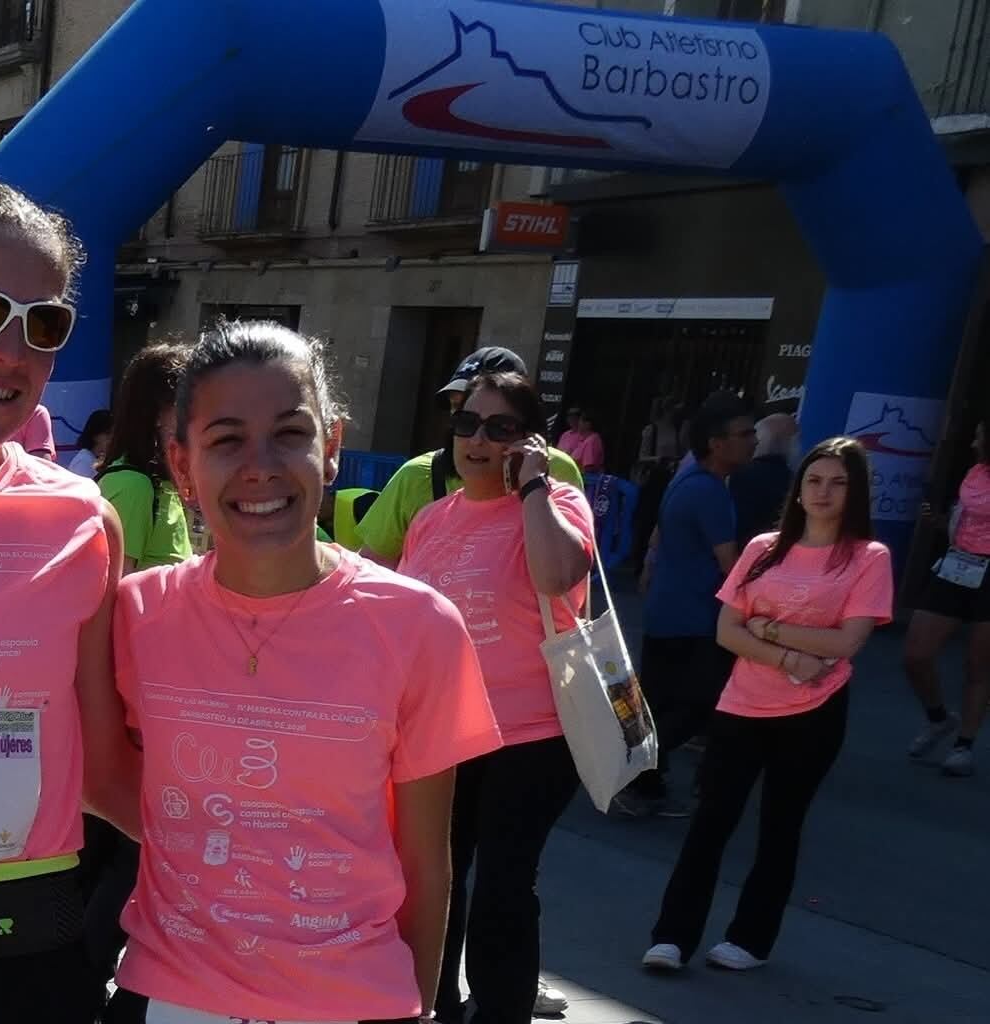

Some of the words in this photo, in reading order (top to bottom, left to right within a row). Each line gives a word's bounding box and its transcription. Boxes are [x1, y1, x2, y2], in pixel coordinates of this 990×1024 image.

[578, 22, 641, 49] Club
[650, 31, 758, 60] Atletismo
[582, 54, 759, 104] Barbastro
[503, 214, 560, 234] STIHL
